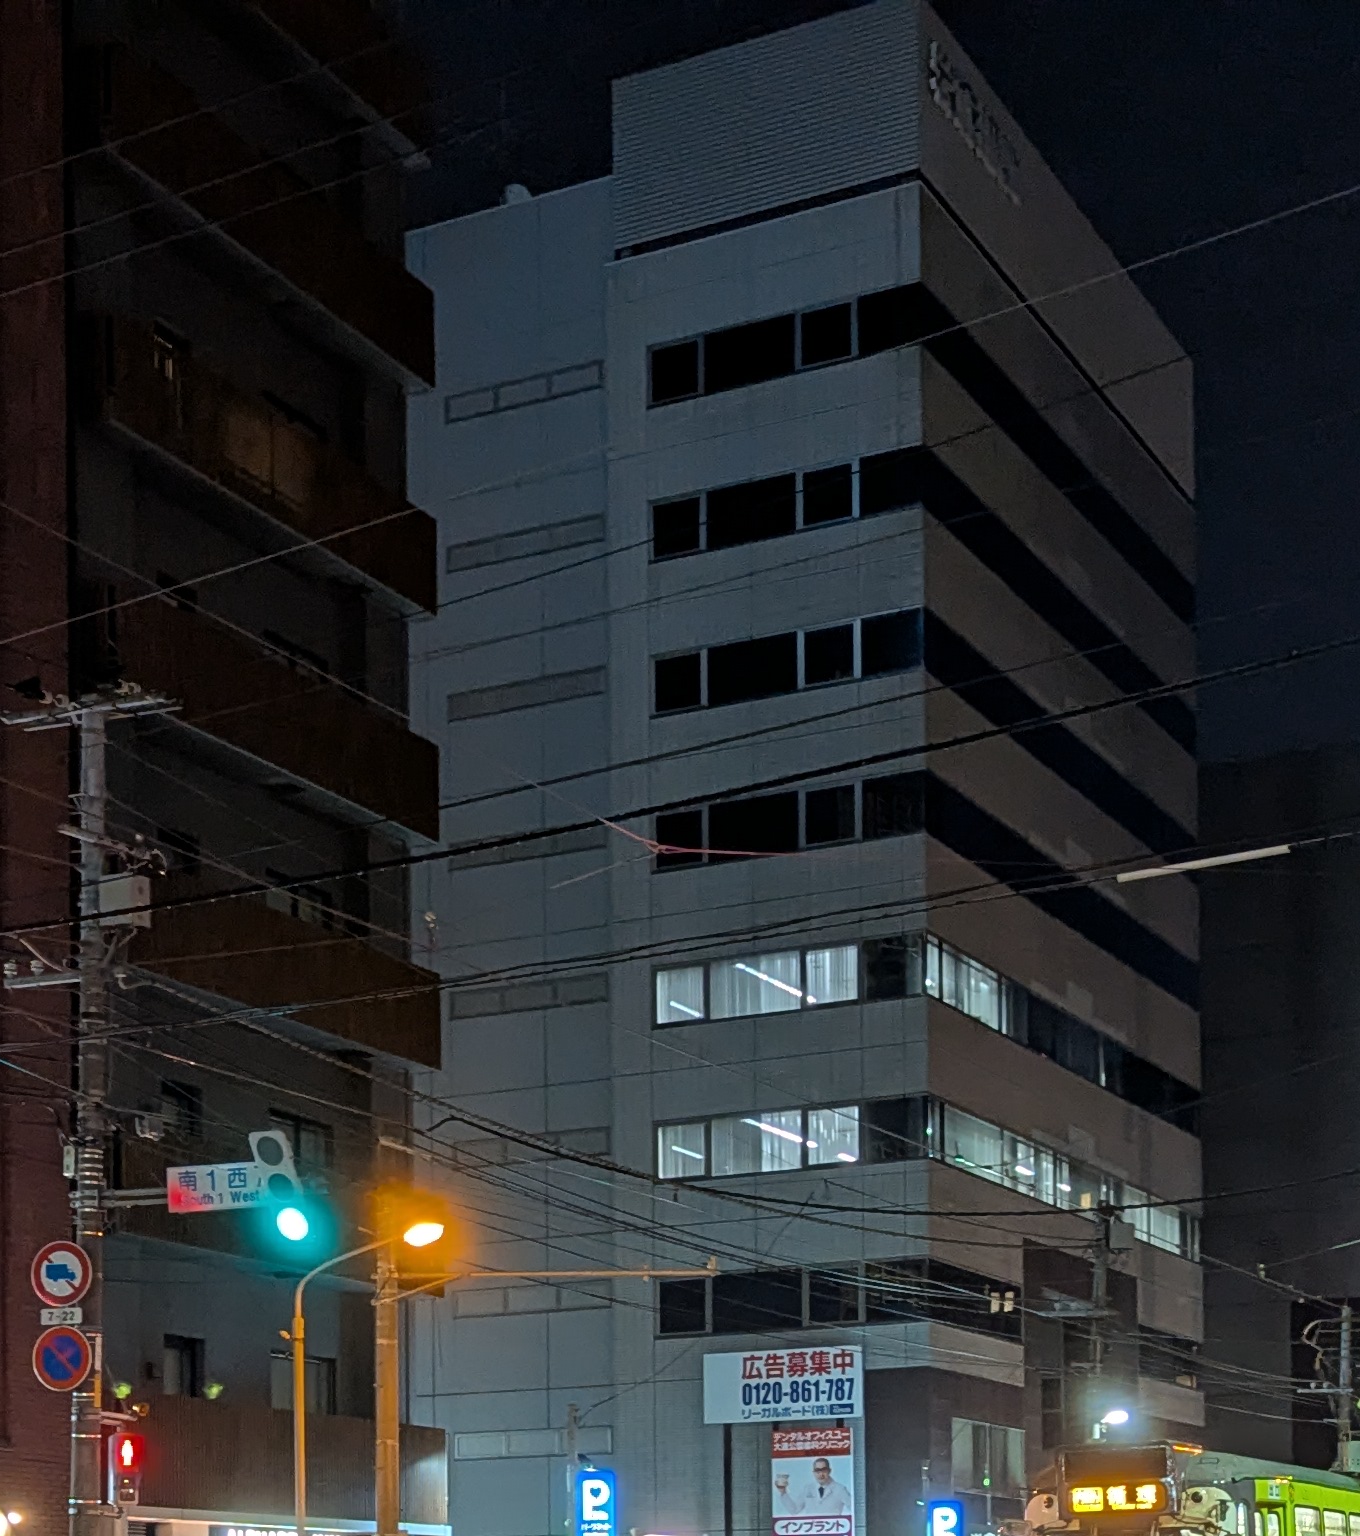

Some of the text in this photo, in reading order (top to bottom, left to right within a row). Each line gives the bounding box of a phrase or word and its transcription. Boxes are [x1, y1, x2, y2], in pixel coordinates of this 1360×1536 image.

[178, 1168, 261, 1191] 南1西
[218, 1193, 224, 1204] 1
[230, 1190, 260, 1203] West
[47, 1310, 76, 1322] 7-22
[742, 1350, 854, 1380] 広告募集中
[742, 1378, 855, 1406] 0120-861-787
[780, 1520, 845, 1533] インプラント
